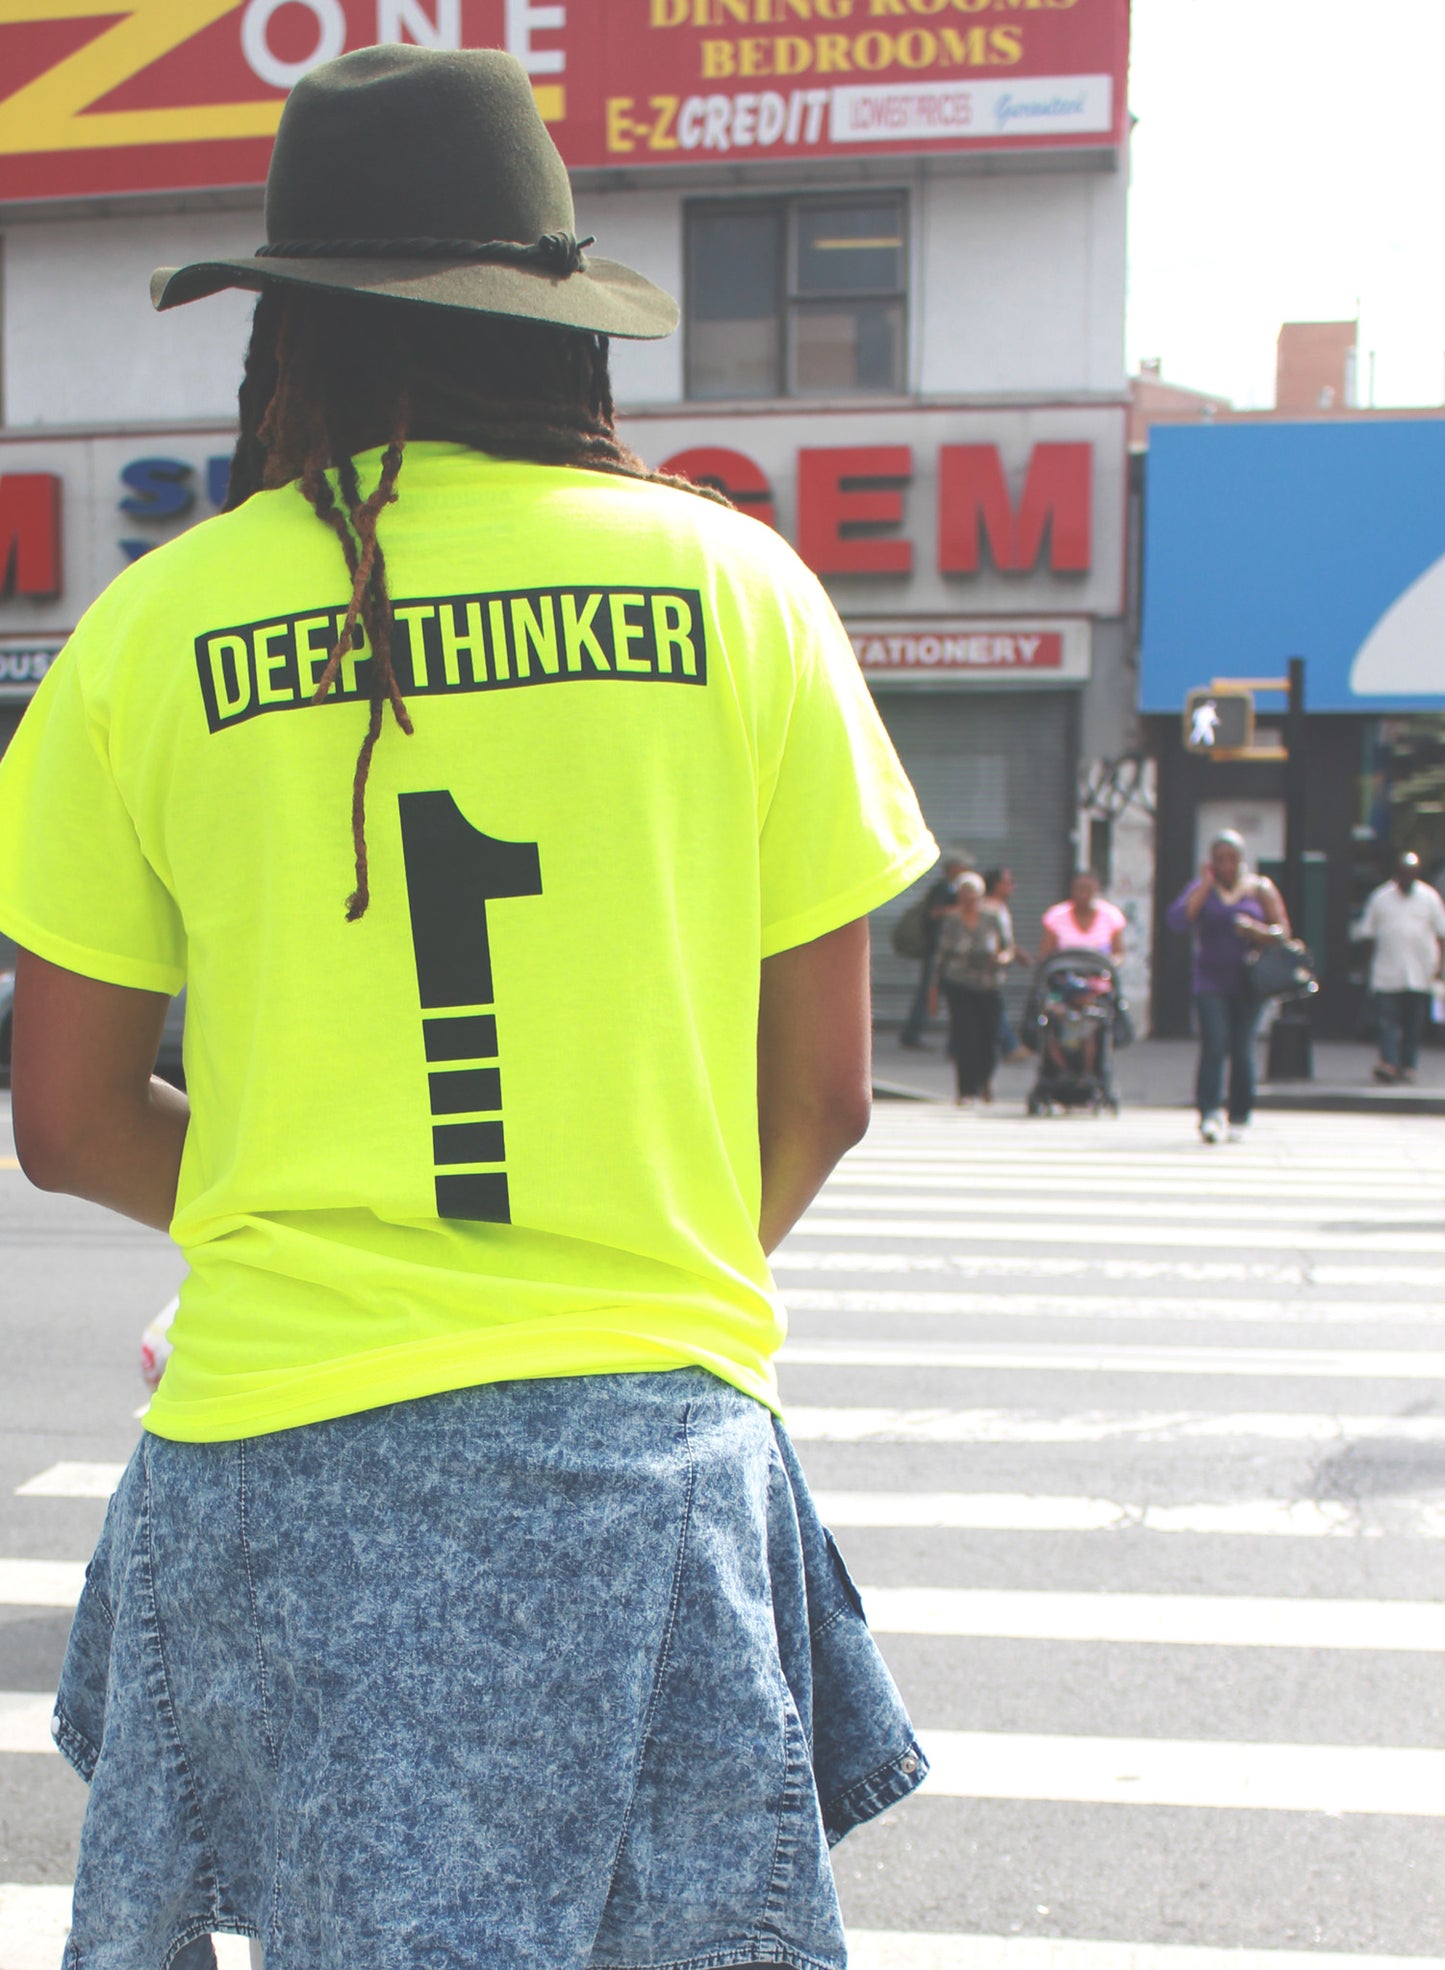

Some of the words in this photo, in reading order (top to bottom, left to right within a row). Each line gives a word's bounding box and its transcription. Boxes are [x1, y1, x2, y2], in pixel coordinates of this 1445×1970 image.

[700, 25, 1023, 79] BEDROOMS
[677, 87, 831, 151] CREDIT
[207, 611, 373, 720] DEEP
[394, 593, 697, 687] THINKER
[398, 789, 543, 1225] 1
